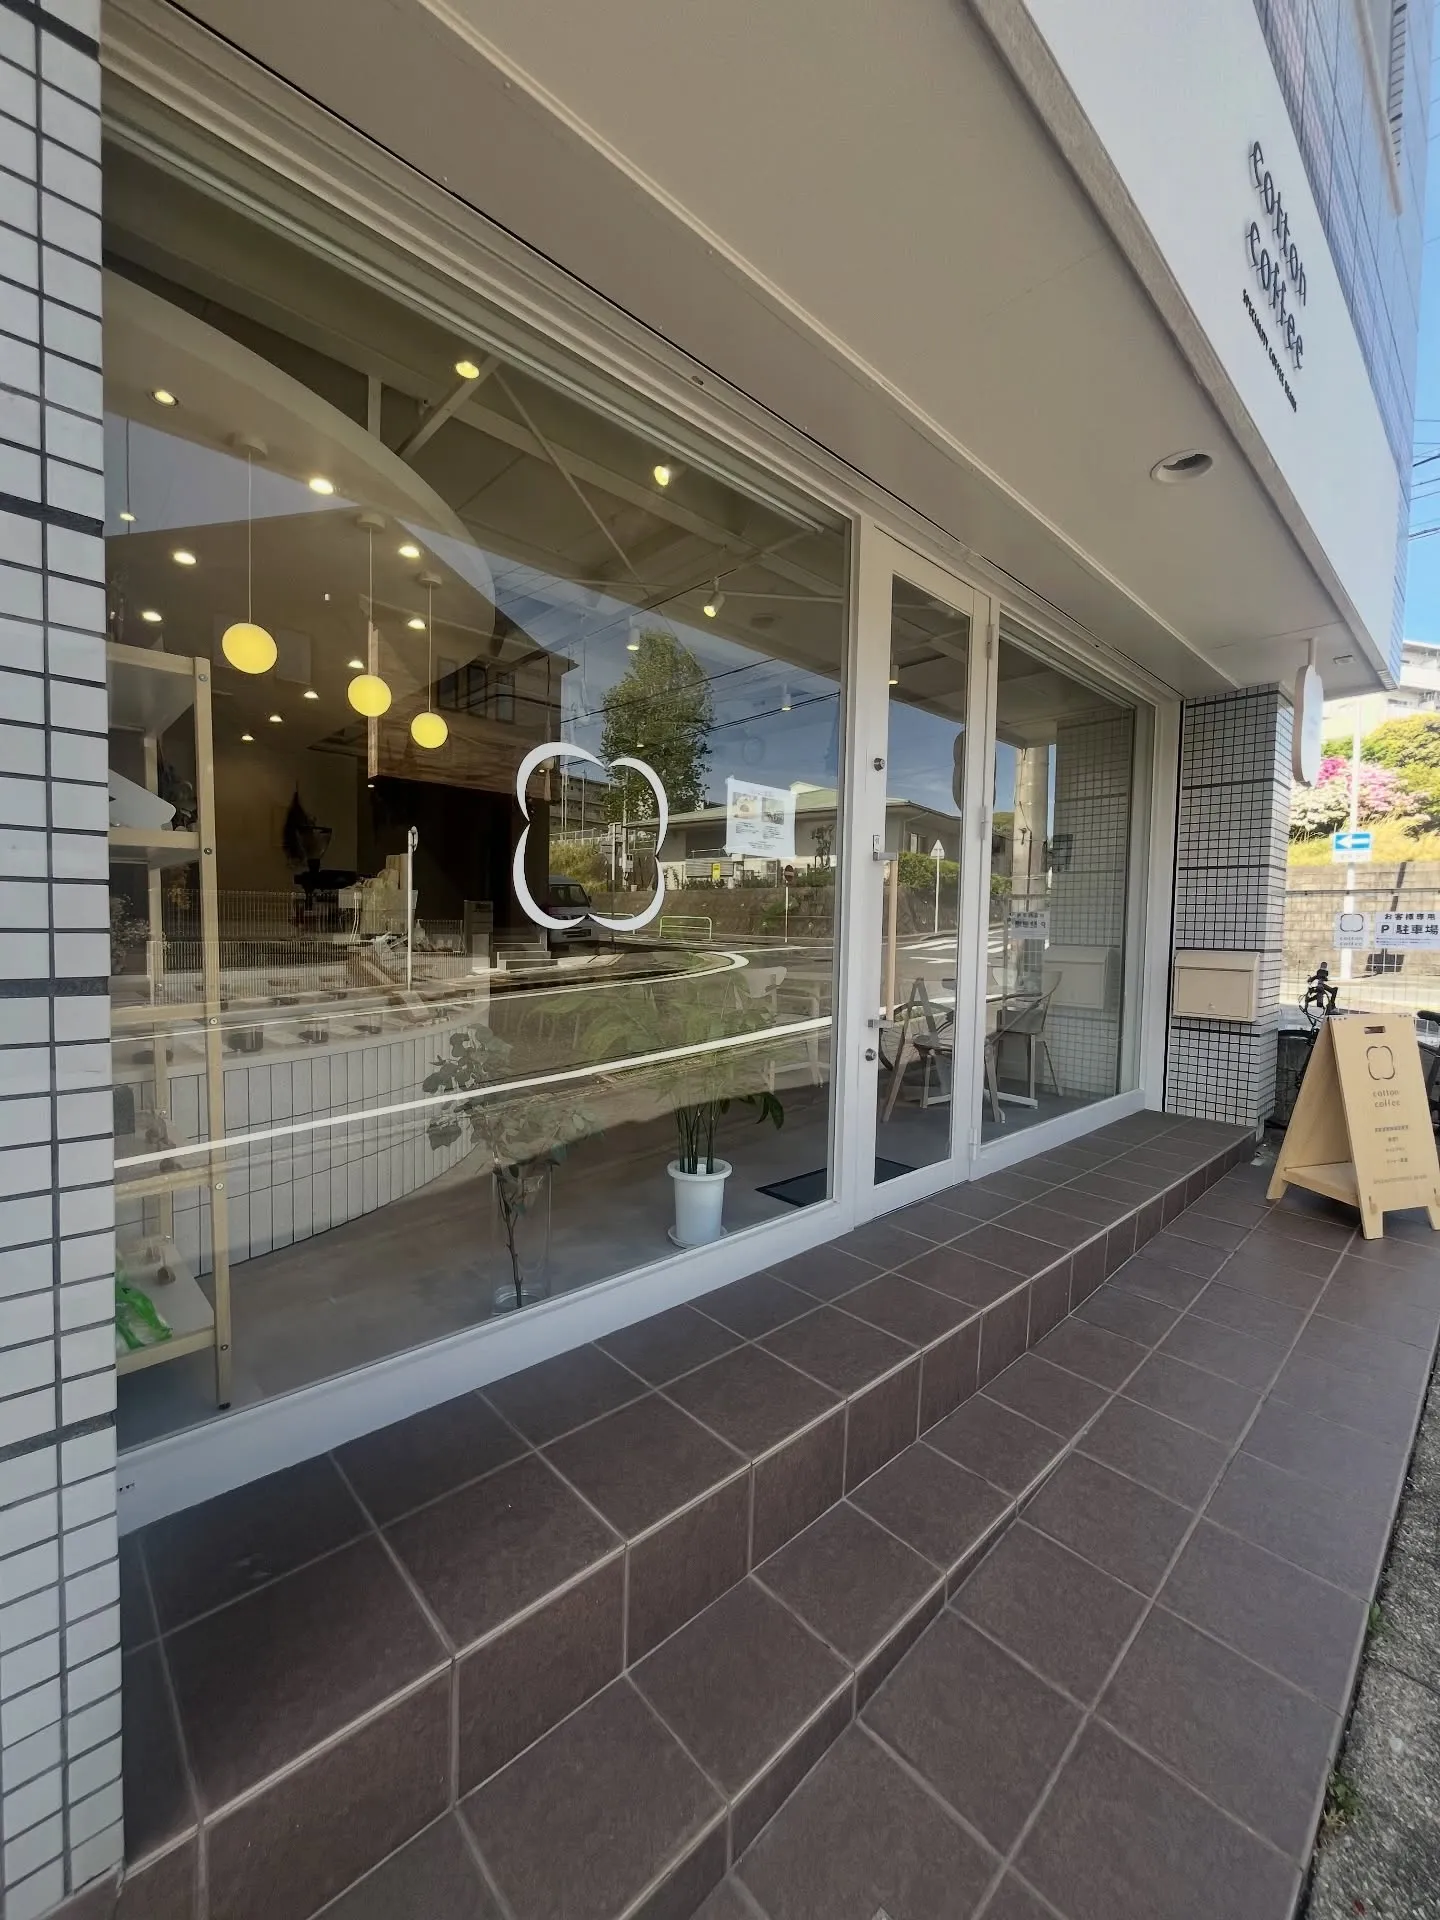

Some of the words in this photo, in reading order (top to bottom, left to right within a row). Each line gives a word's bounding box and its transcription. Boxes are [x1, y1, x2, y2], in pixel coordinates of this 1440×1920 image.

[1384, 913, 1436, 921] お客様専用
[1380, 924, 1390, 934] P
[1396, 924, 1439, 935] 駐車場
